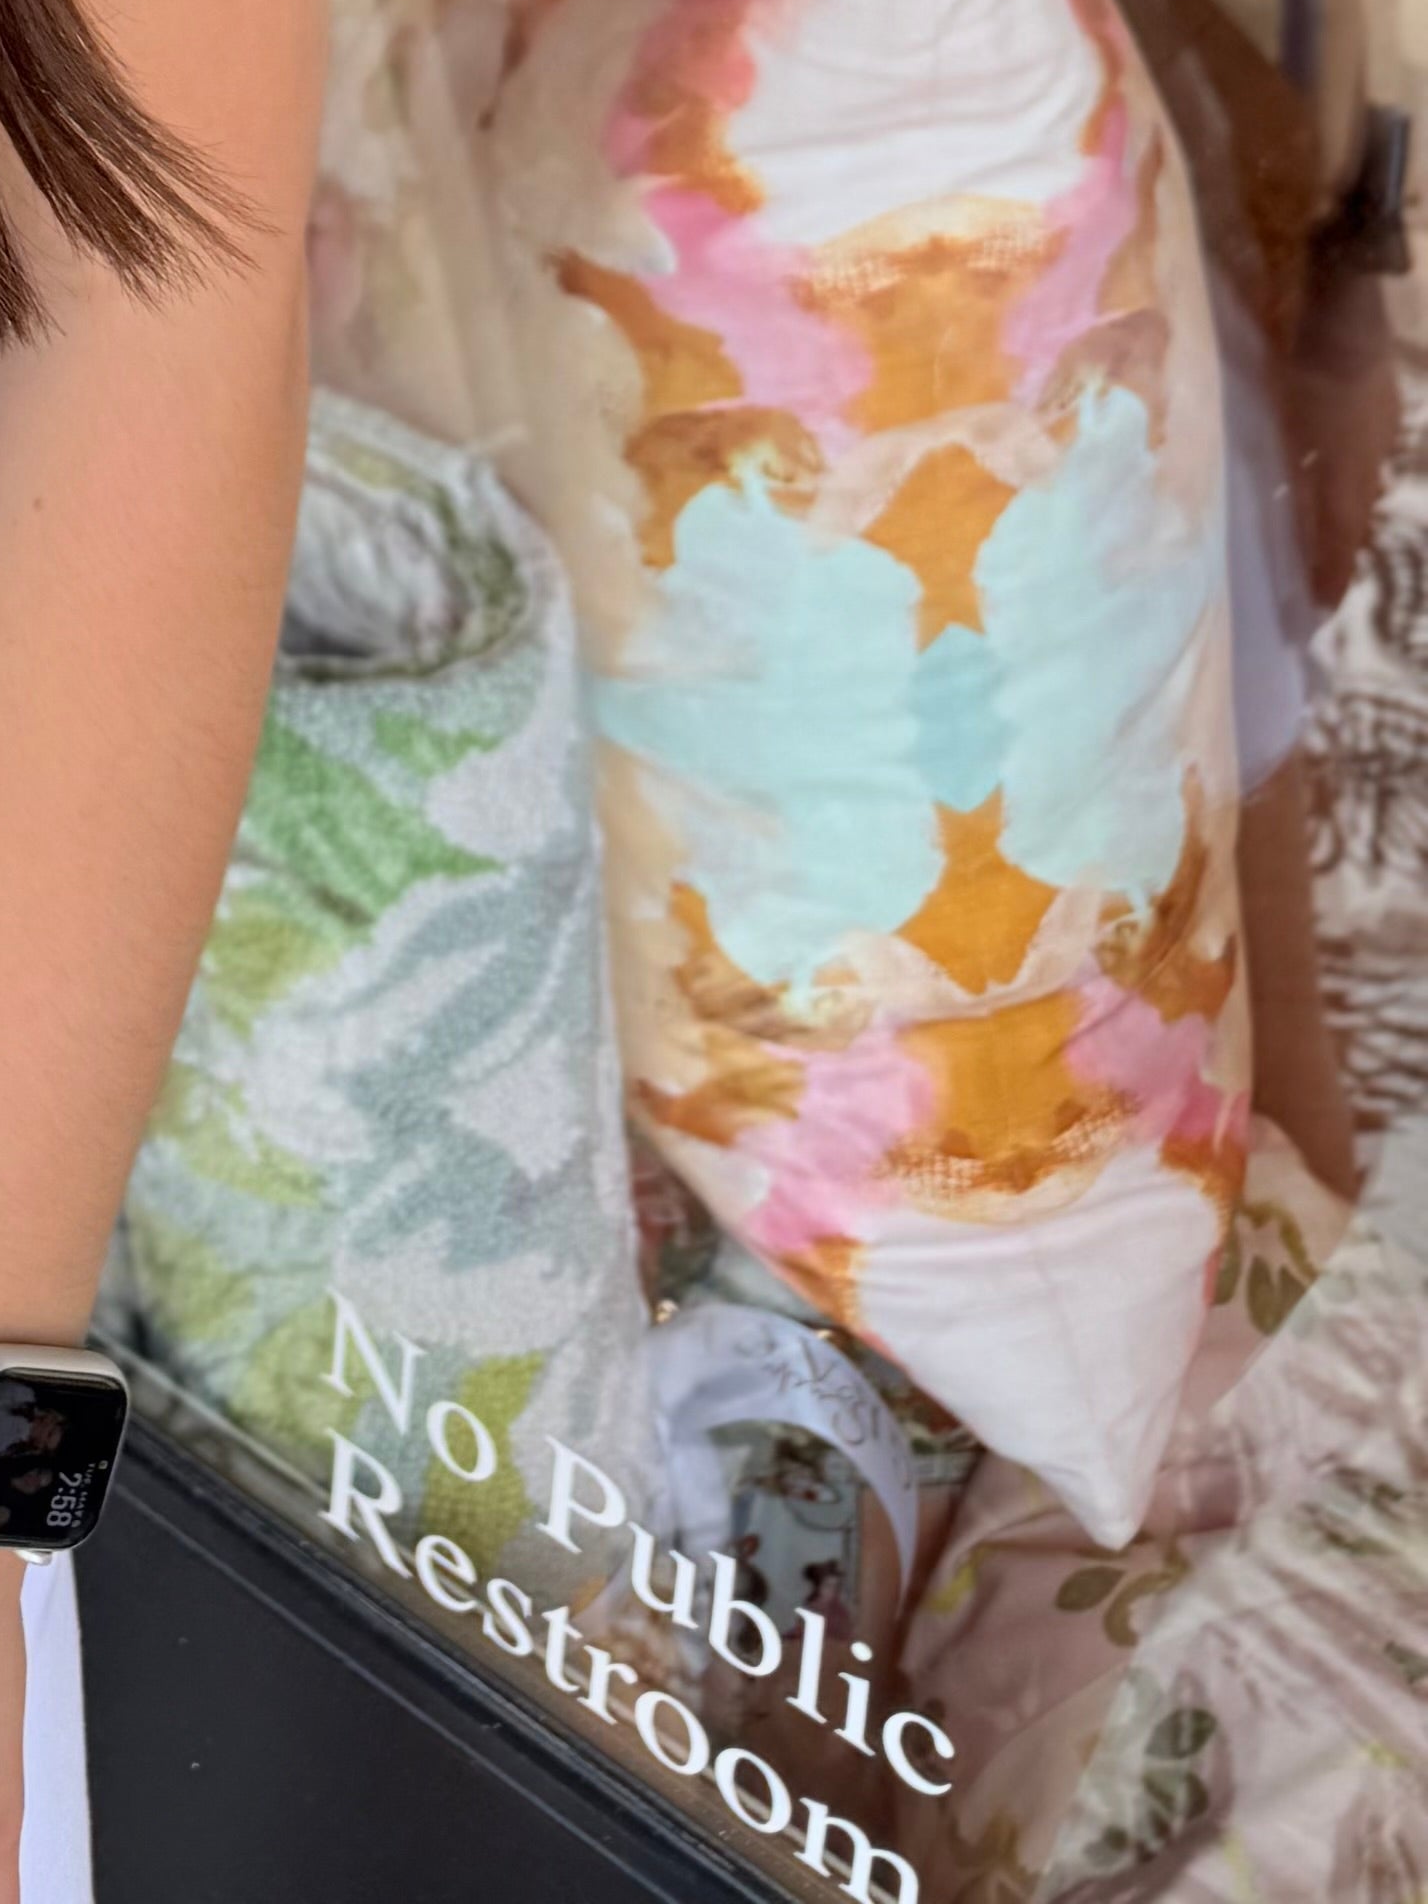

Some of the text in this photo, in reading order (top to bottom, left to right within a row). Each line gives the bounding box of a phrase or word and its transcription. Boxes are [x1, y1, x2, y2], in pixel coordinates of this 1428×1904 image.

[46, 1471, 83, 1527] 2:58
[318, 1426, 924, 1904] Restroom
[320, 1285, 498, 1483] No
[537, 1434, 956, 1795] Public
